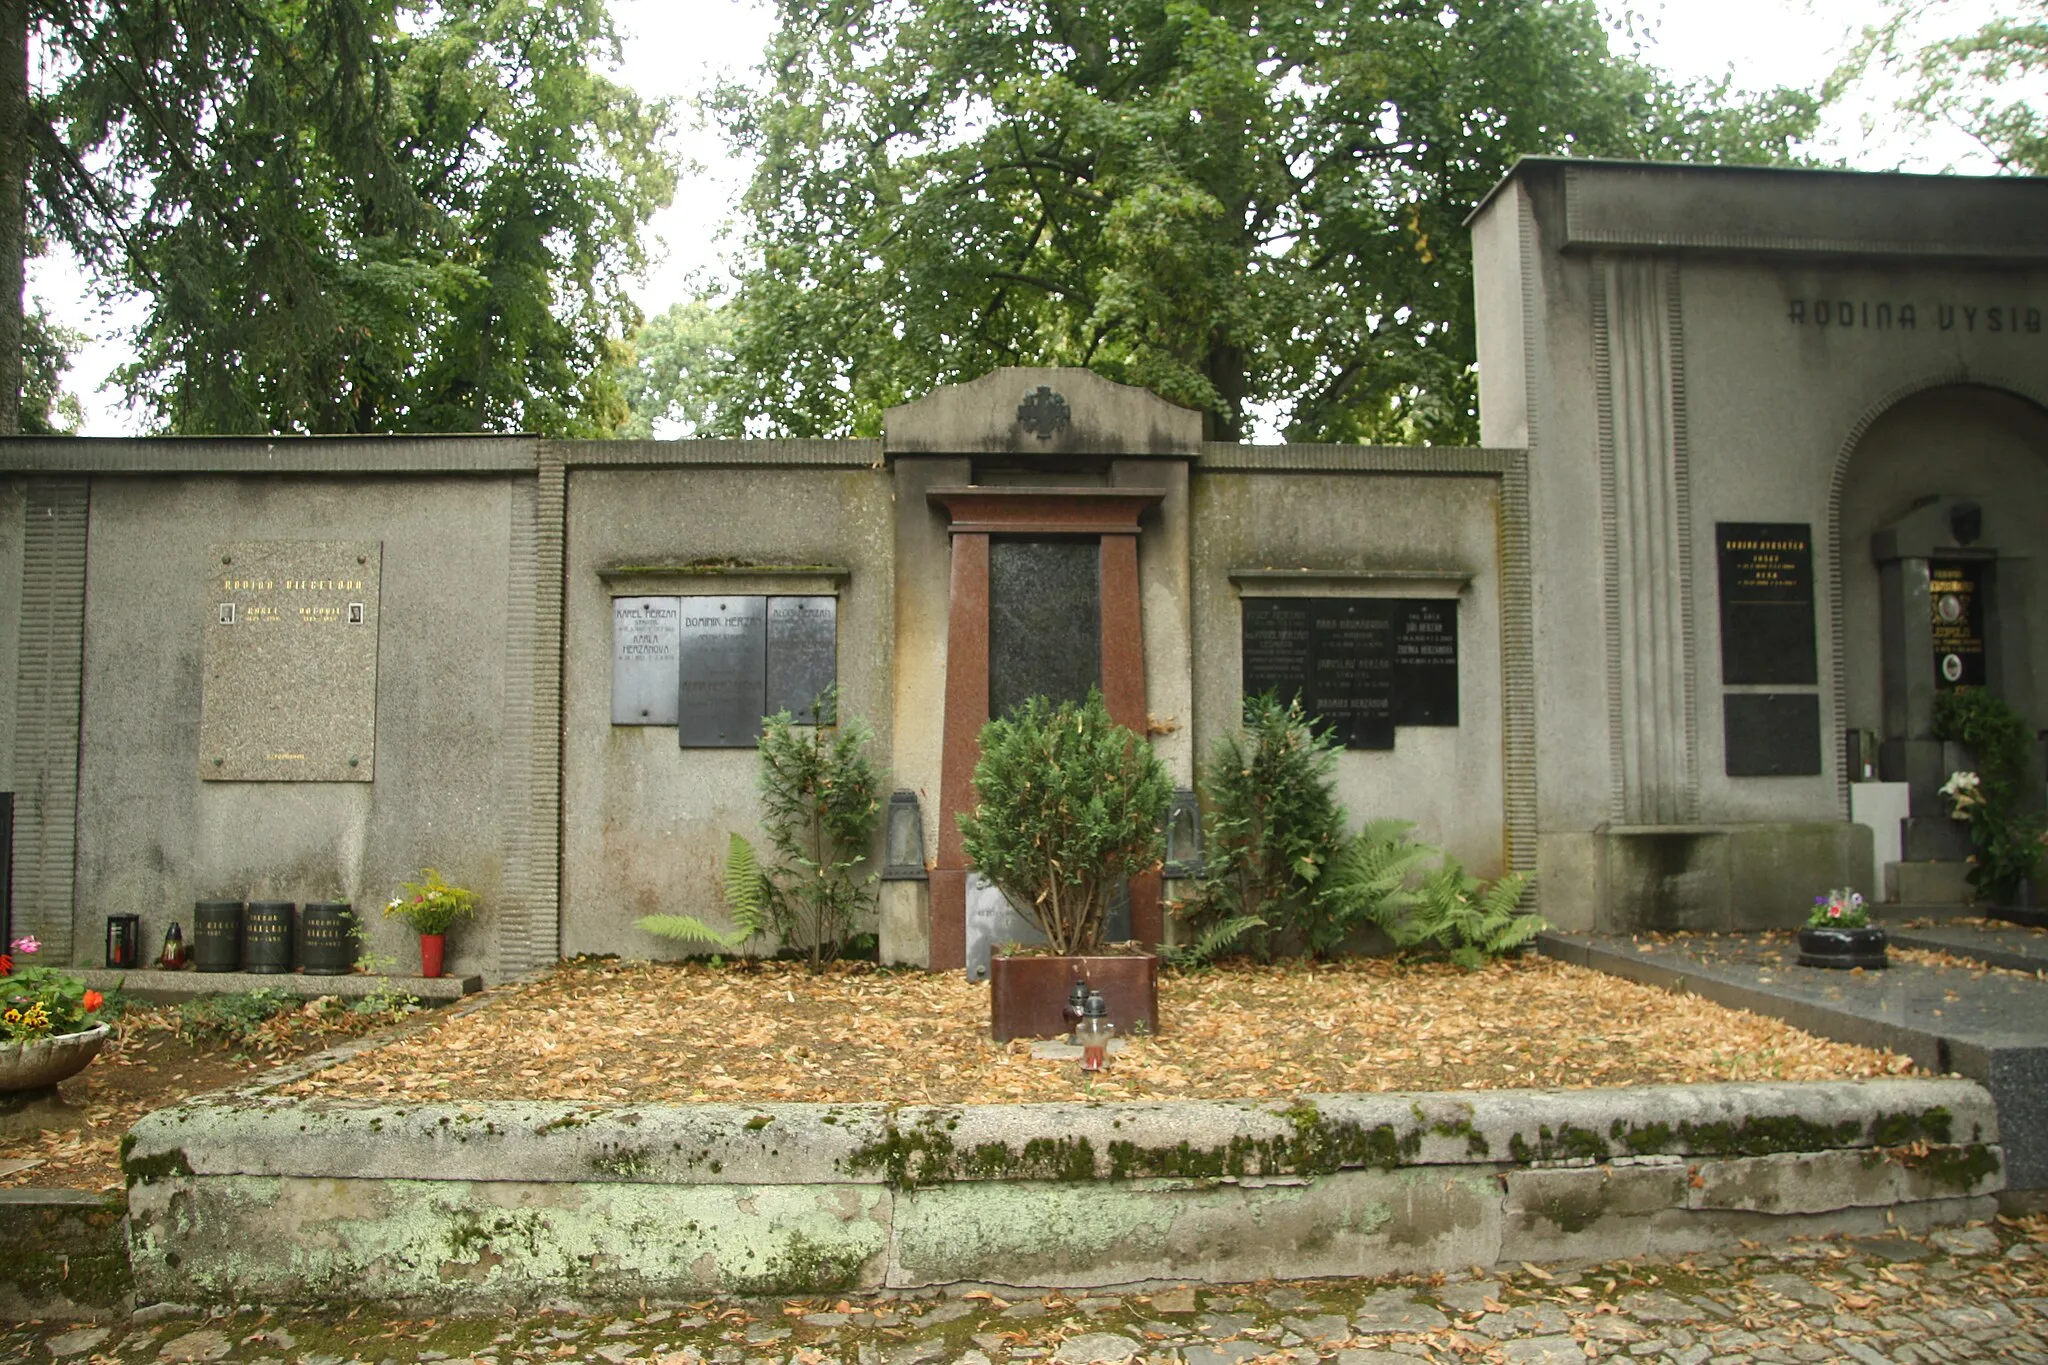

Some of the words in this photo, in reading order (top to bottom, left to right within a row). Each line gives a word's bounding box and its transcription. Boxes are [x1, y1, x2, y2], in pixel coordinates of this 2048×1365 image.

[1788, 300, 1916, 330] RODINA
[616, 609, 642, 619] KAREL
[685, 616, 722, 627] DOMINIK
[633, 634, 659, 644] KARLA
